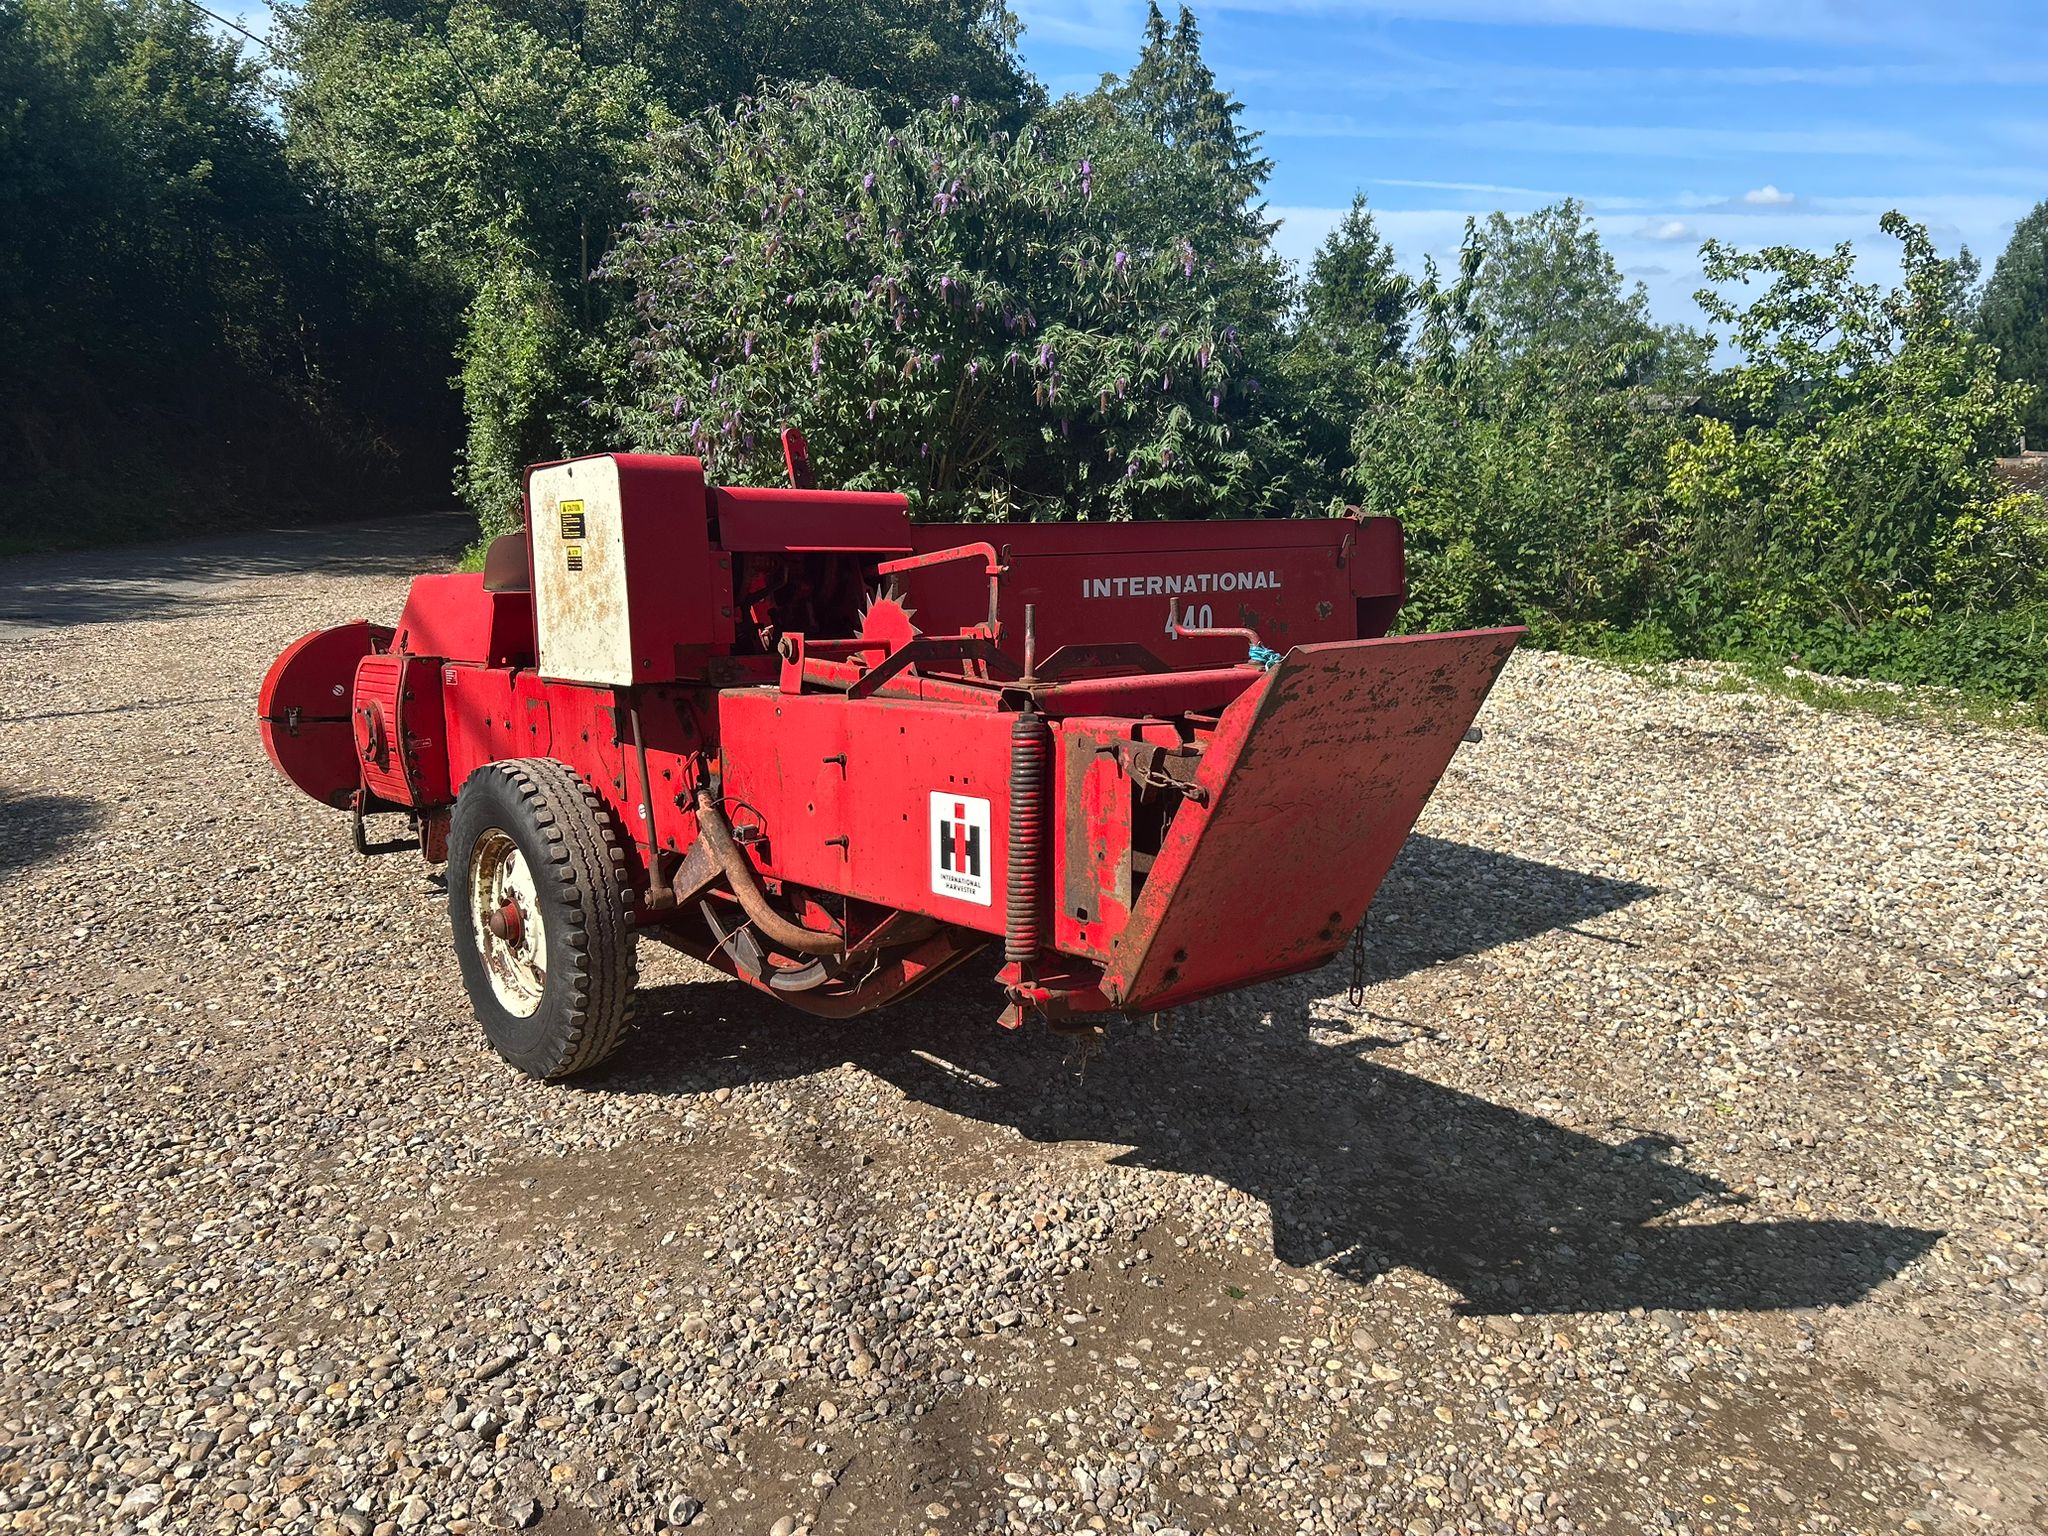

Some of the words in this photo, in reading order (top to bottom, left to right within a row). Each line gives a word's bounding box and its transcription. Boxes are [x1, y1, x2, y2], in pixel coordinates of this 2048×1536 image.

[1083, 571, 1281, 598] INTERNATIONAL
[1165, 605, 1212, 640] 440
[941, 874, 981, 888] INTERNATIONAL
[946, 883, 976, 895] HARVESTER
